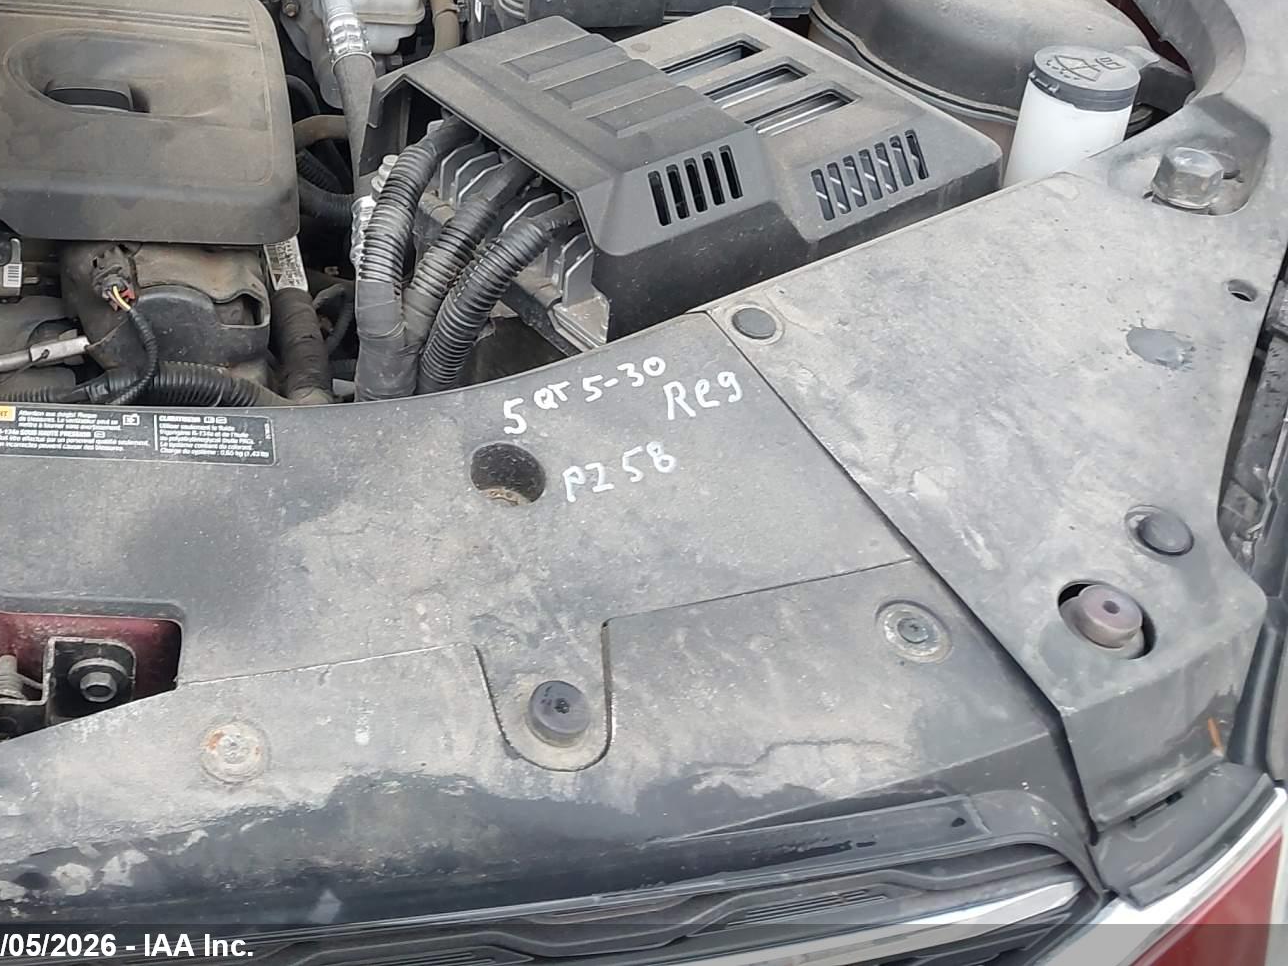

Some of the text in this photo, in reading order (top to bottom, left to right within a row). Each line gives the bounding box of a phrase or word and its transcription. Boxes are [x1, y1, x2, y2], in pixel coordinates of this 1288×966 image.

[503, 398, 527, 434] 5
[582, 356, 666, 402] 5-30
[663, 371, 743, 420] Reg
